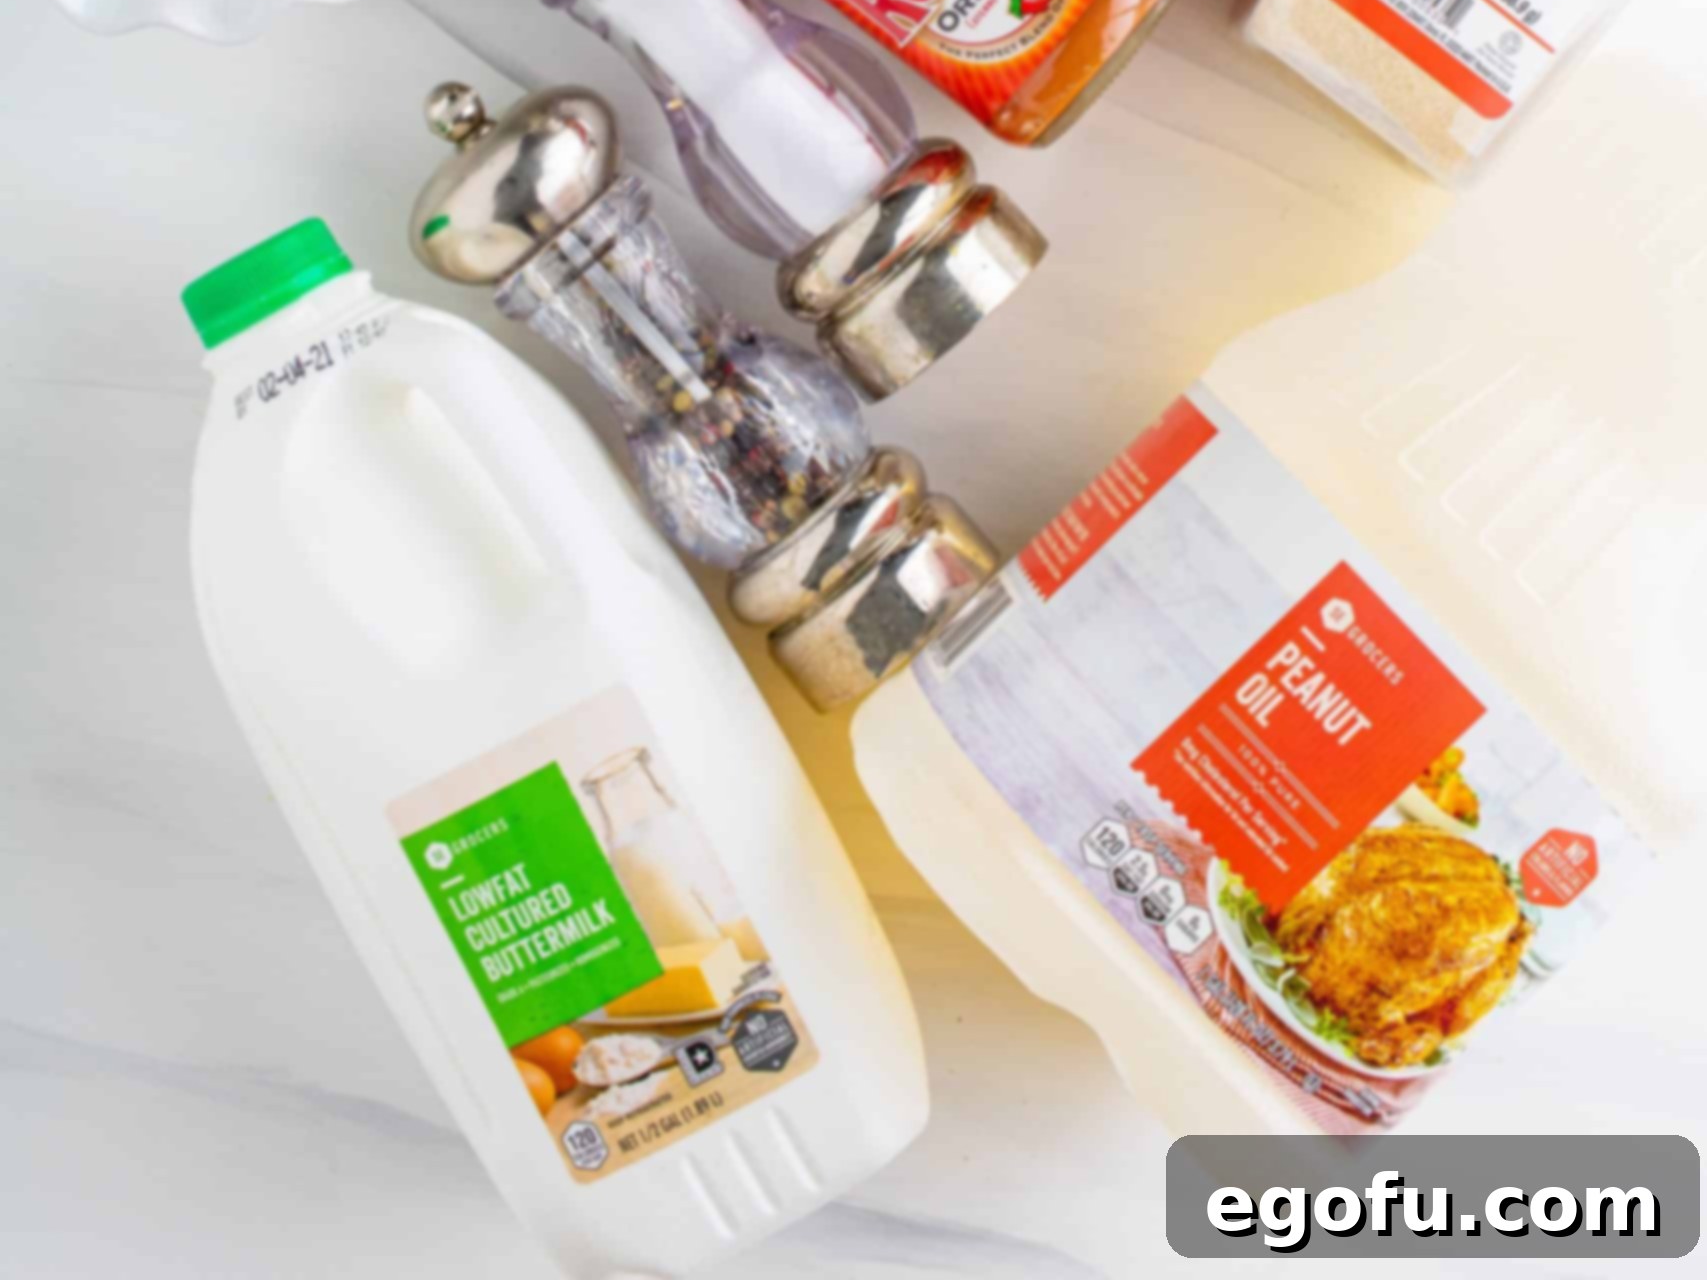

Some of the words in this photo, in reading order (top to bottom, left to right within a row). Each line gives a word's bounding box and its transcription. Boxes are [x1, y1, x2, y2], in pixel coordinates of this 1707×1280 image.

[257, 340, 334, 402] 02-04-21
[1346, 625, 1403, 685] GROCERS
[1235, 672, 1286, 727] OIL
[1266, 641, 1371, 746] PEANUT
[1238, 744, 1267, 775] 100%
[1269, 777, 1300, 809] PURE
[450, 817, 508, 855] GROCERS
[1096, 826, 1125, 856] 120
[448, 863, 531, 922] LOWFAT
[464, 881, 573, 953] CULTURED
[480, 897, 615, 983] BUTTERMILK
[566, 1126, 597, 1153] 120
[618, 1133, 639, 1154] NET
[638, 1122, 661, 1143] 1/2
[659, 1113, 682, 1133] GAL
